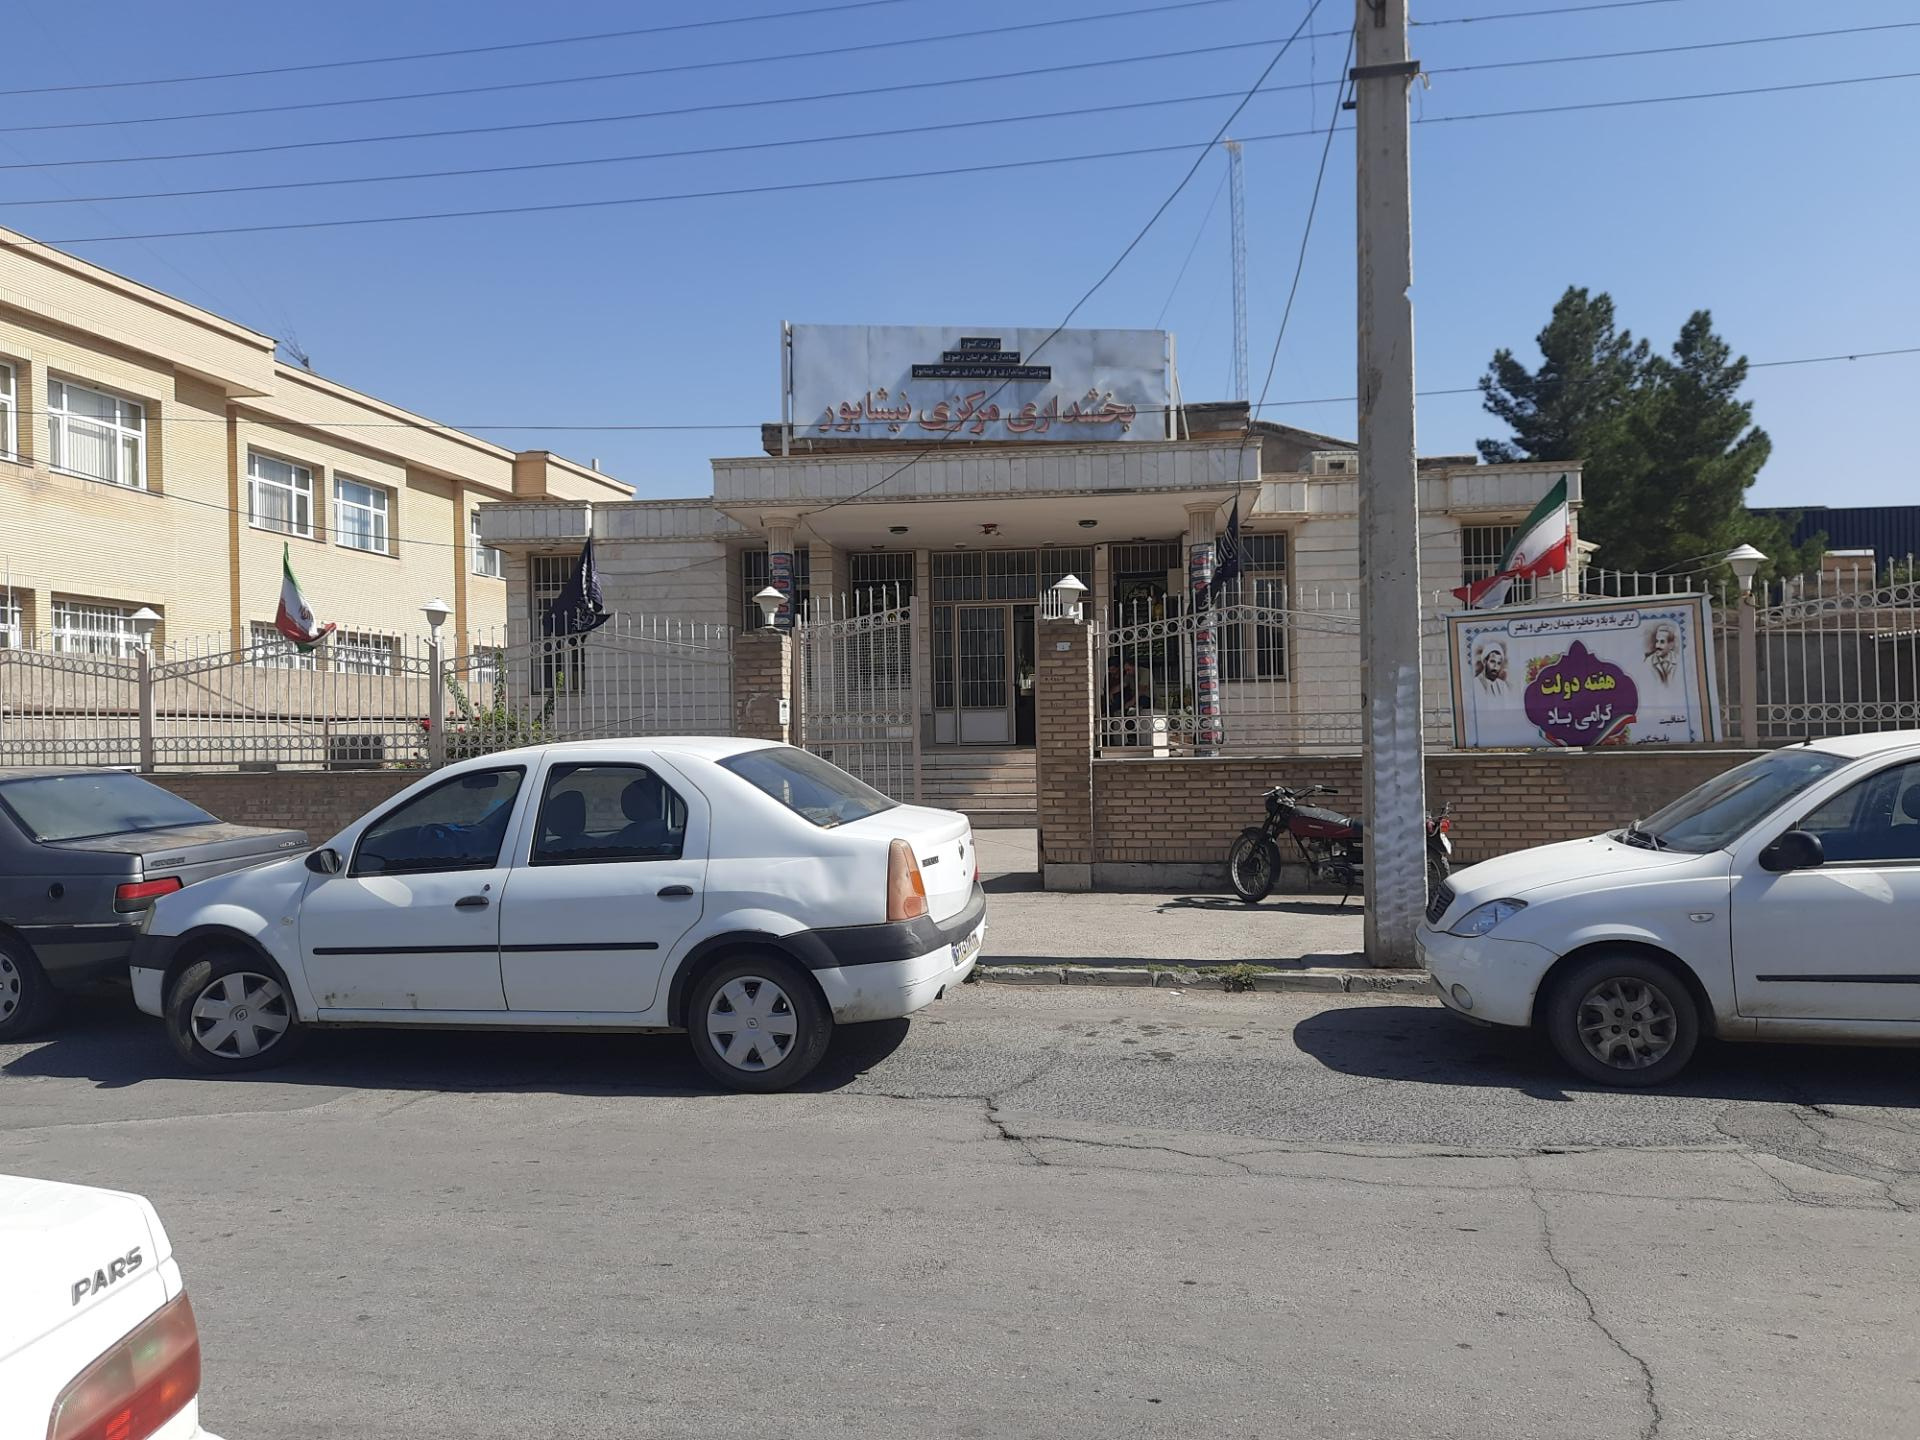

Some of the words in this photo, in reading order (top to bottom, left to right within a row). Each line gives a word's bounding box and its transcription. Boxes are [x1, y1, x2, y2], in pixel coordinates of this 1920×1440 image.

[817, 387, 912, 433] نیشابور
[918, 389, 1001, 434] مرکزی
[1006, 387, 1137, 434] بخشداری
[1541, 672, 1581, 700] دولت
[1584, 671, 1616, 691] هفته
[1548, 706, 1572, 728] باد
[1574, 703, 1612, 730] گرامی
[71, 1246, 143, 1306] PARS
